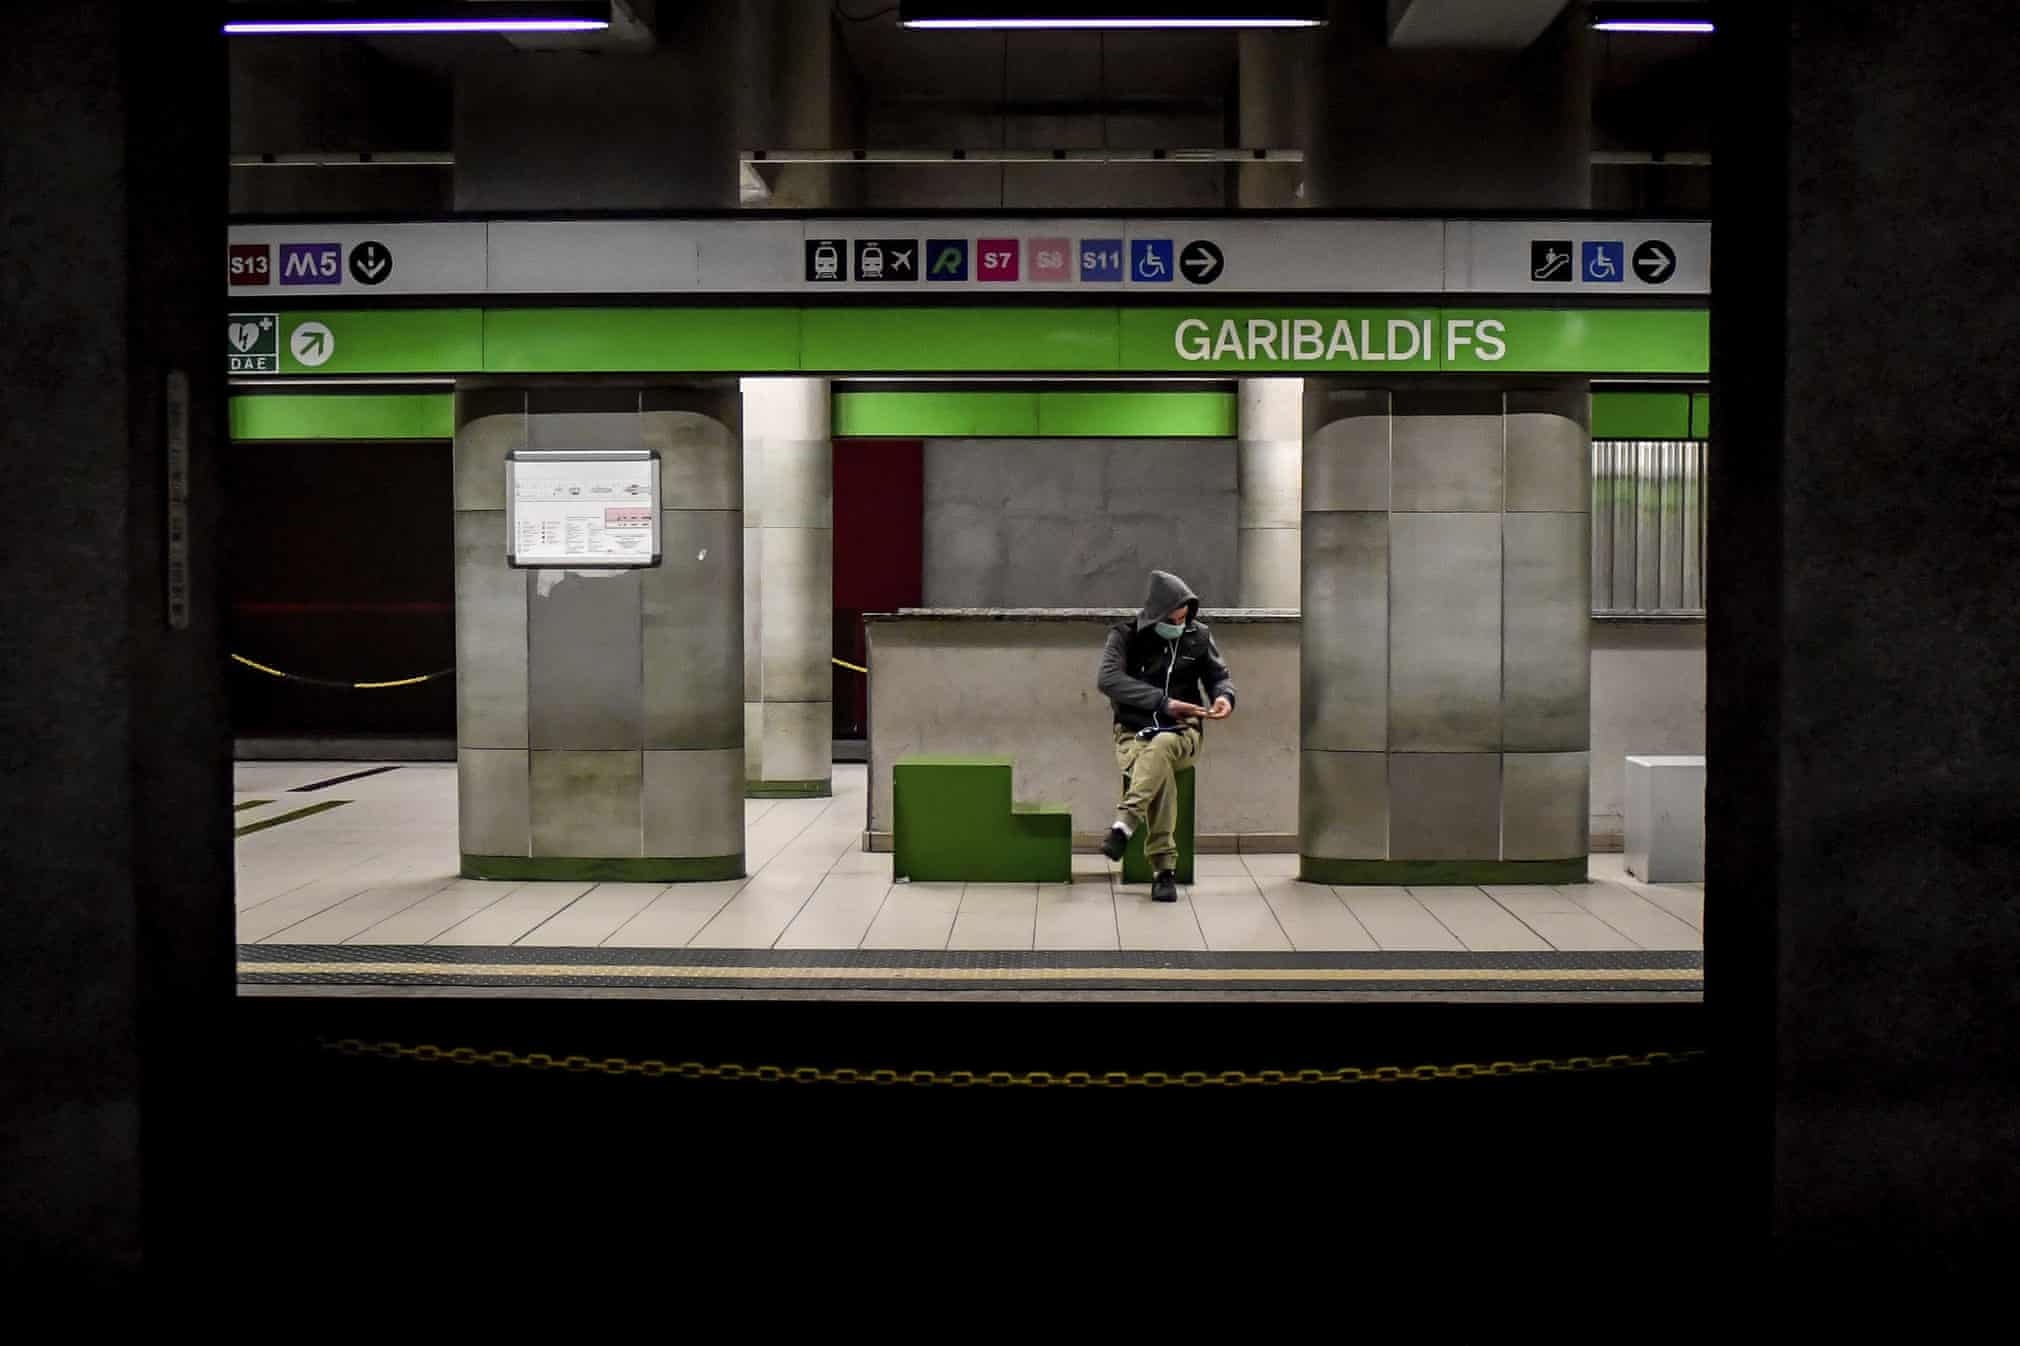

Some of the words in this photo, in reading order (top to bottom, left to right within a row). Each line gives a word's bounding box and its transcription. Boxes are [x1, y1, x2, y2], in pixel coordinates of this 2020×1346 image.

[231, 256, 268, 274] S13
[284, 251, 337, 278] M5
[984, 251, 1012, 269] S7
[1082, 251, 1120, 269] S11
[1174, 318, 1432, 361] GARIBALDI
[1447, 318, 1507, 361] FS
[231, 357, 267, 370] DAE
